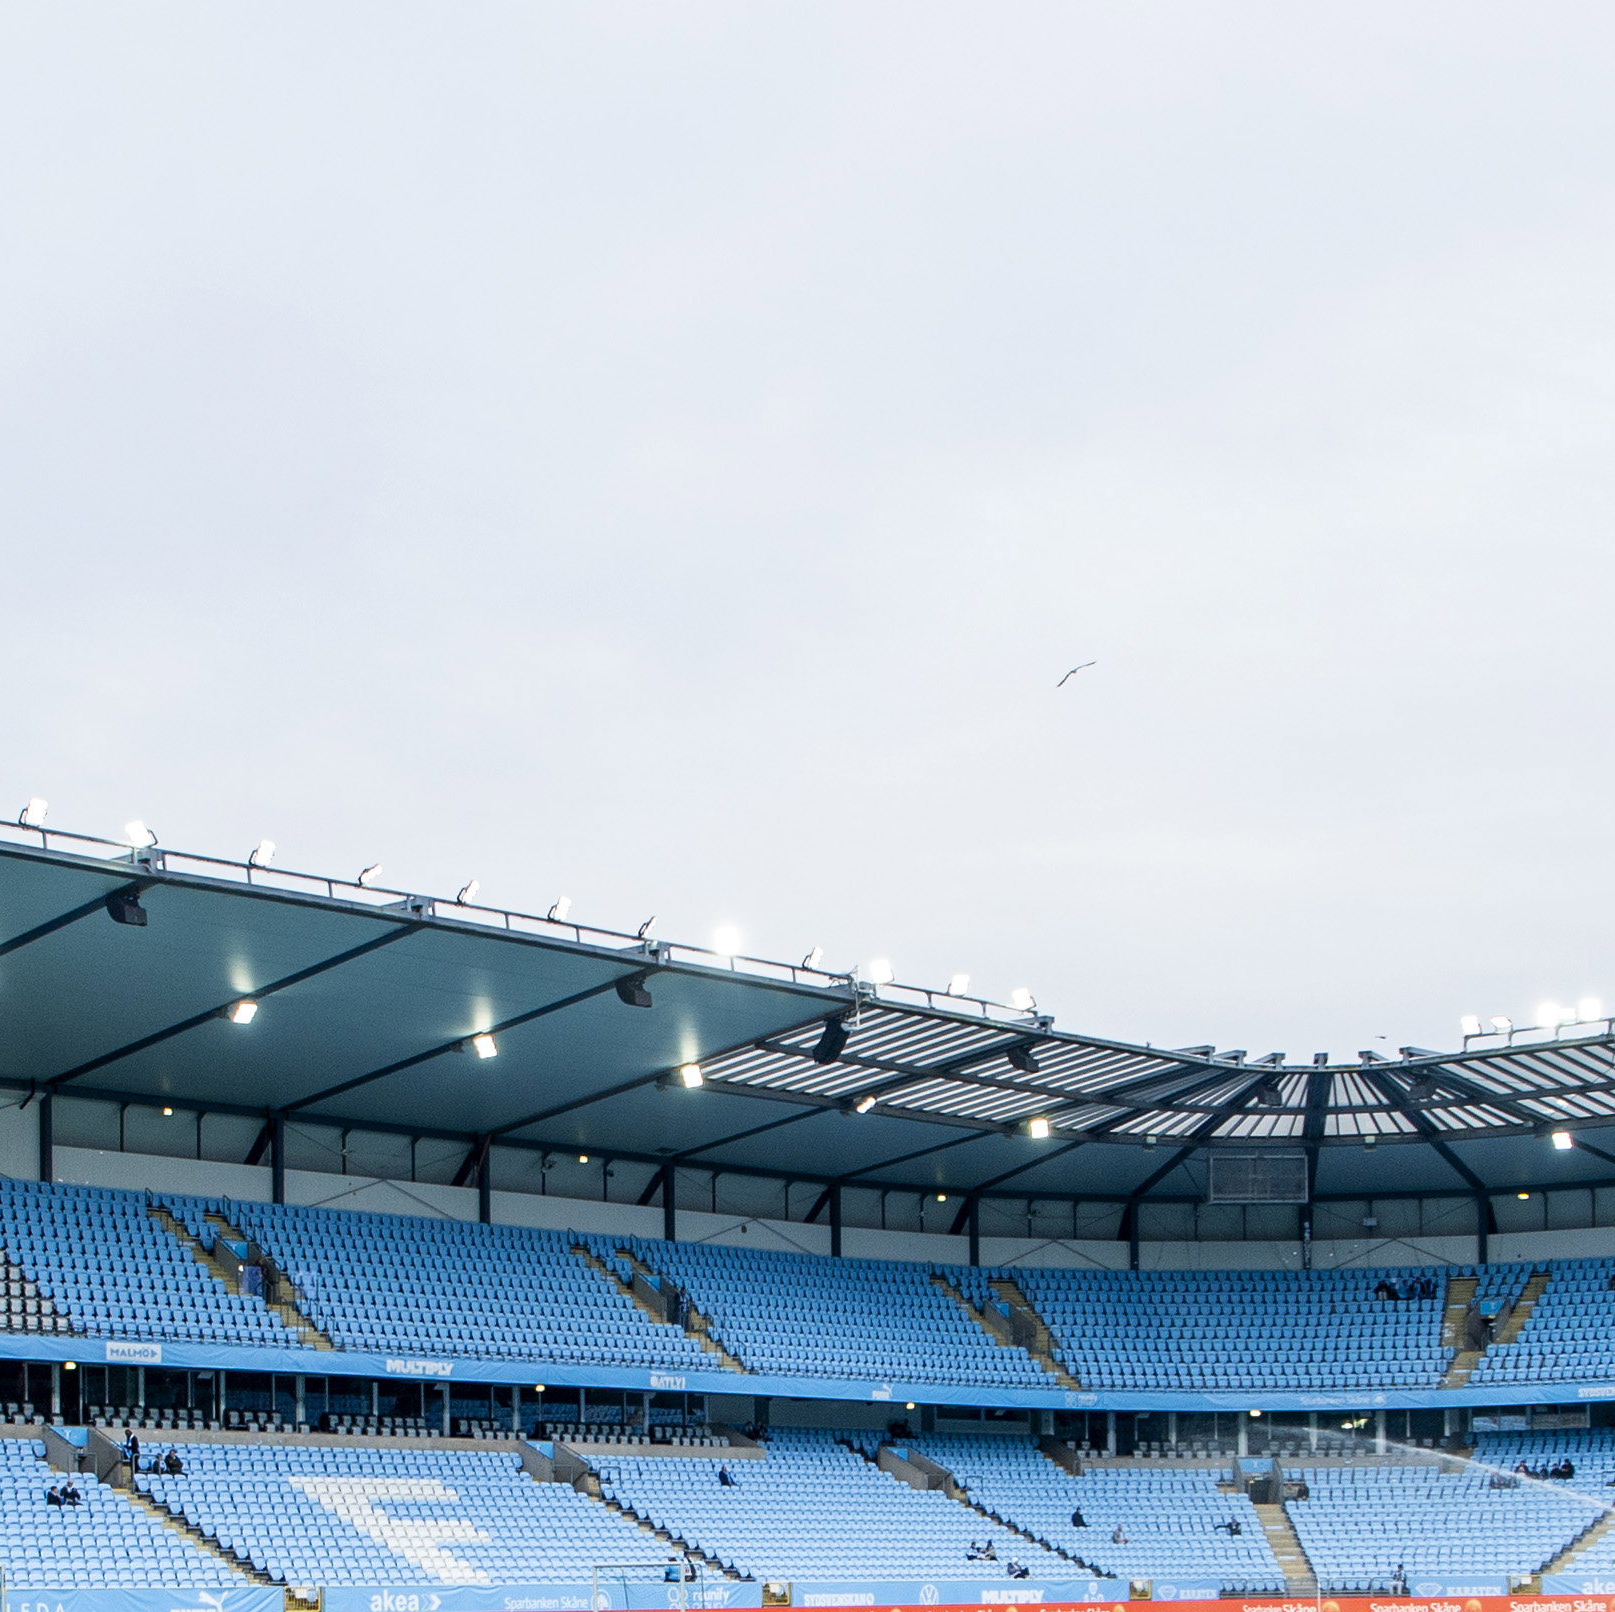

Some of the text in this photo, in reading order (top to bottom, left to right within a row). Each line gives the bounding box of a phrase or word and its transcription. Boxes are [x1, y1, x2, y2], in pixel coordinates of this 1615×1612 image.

[110, 1346, 150, 1358] MALMÖ
[386, 1359, 454, 1376] MULTIPLY
[370, 1590, 419, 1612] akea
[504, 1596, 587, 1611] Sparbanken Skåne
[1574, 1599, 1606, 1612] Skåne
